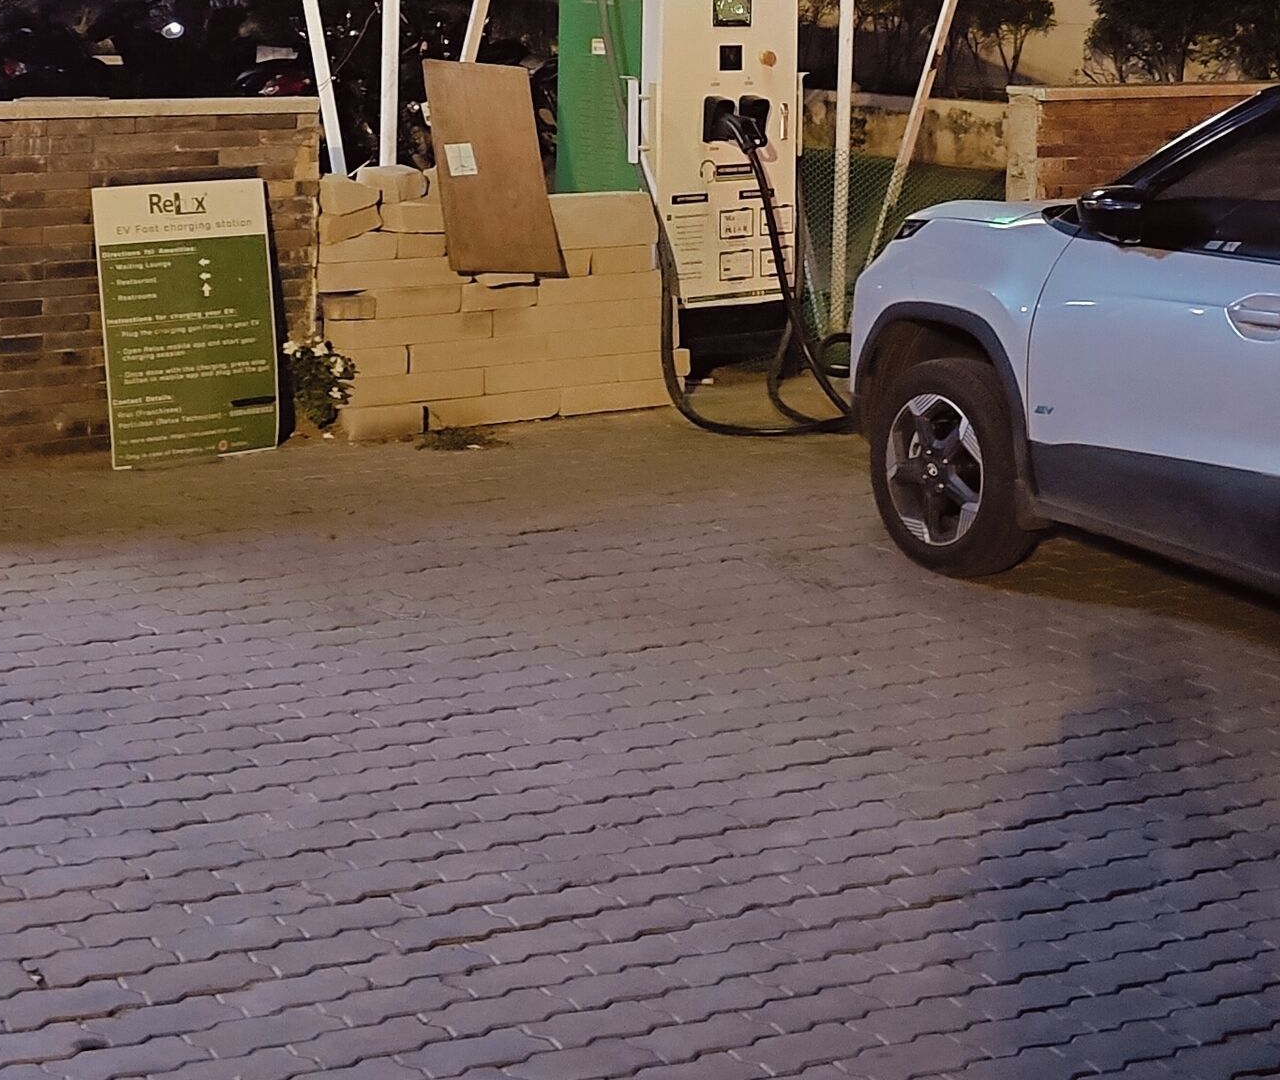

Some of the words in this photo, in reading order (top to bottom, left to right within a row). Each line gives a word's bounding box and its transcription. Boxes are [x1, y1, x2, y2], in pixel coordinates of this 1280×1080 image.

[115, 225, 129, 236] EV
[134, 223, 159, 235] Fast
[162, 220, 211, 233] charging
[214, 217, 252, 230] station
